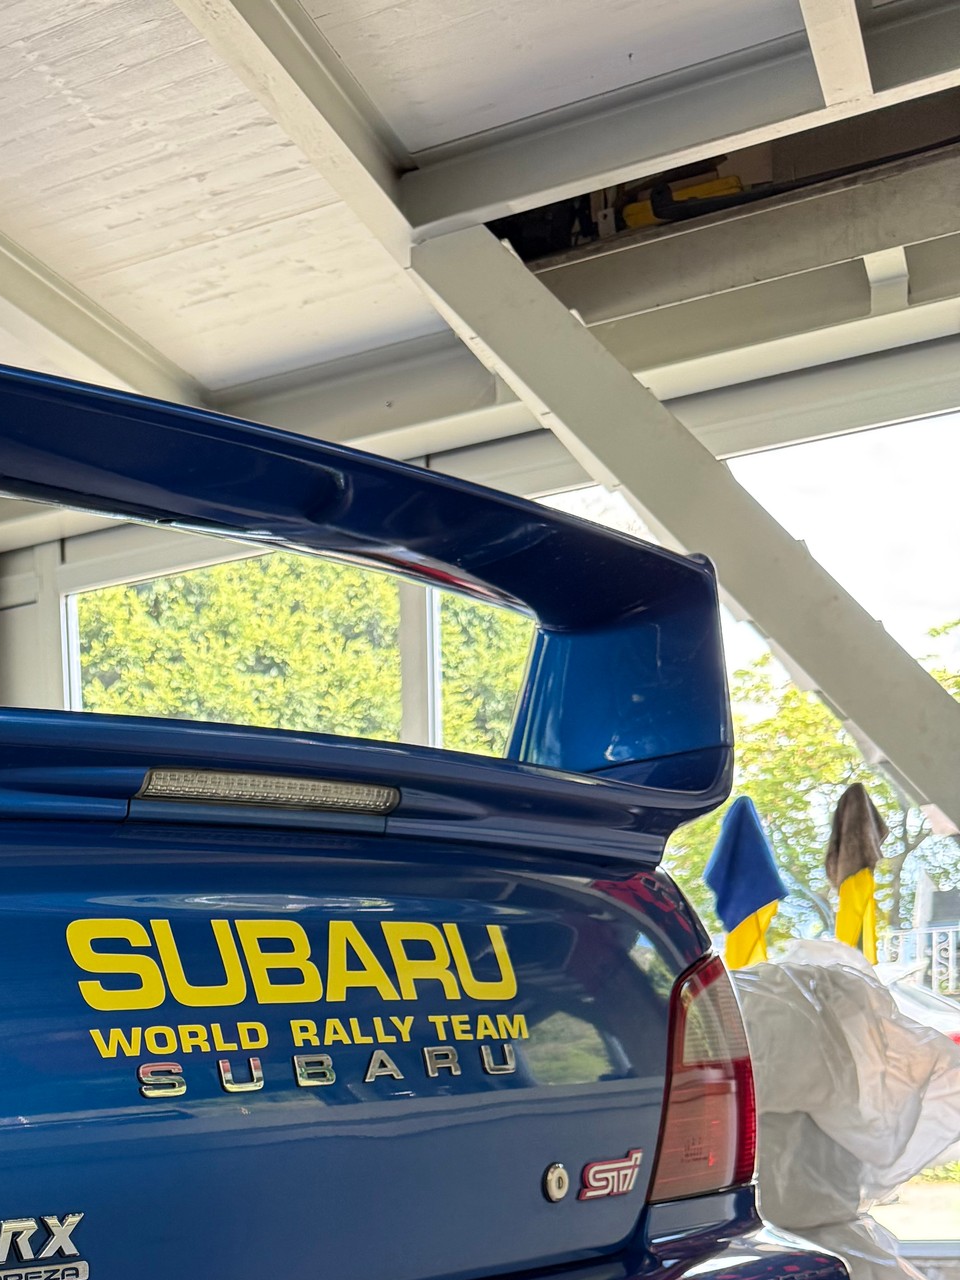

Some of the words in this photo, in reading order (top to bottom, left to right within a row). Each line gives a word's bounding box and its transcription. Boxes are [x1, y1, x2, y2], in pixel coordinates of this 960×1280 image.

[66, 918, 517, 1011] SUBARU
[89, 1021, 269, 1058] WORLD
[290, 1016, 415, 1047] RALLY
[429, 1014, 529, 1041] TEAM
[137, 1043, 517, 1098] SUBARU
